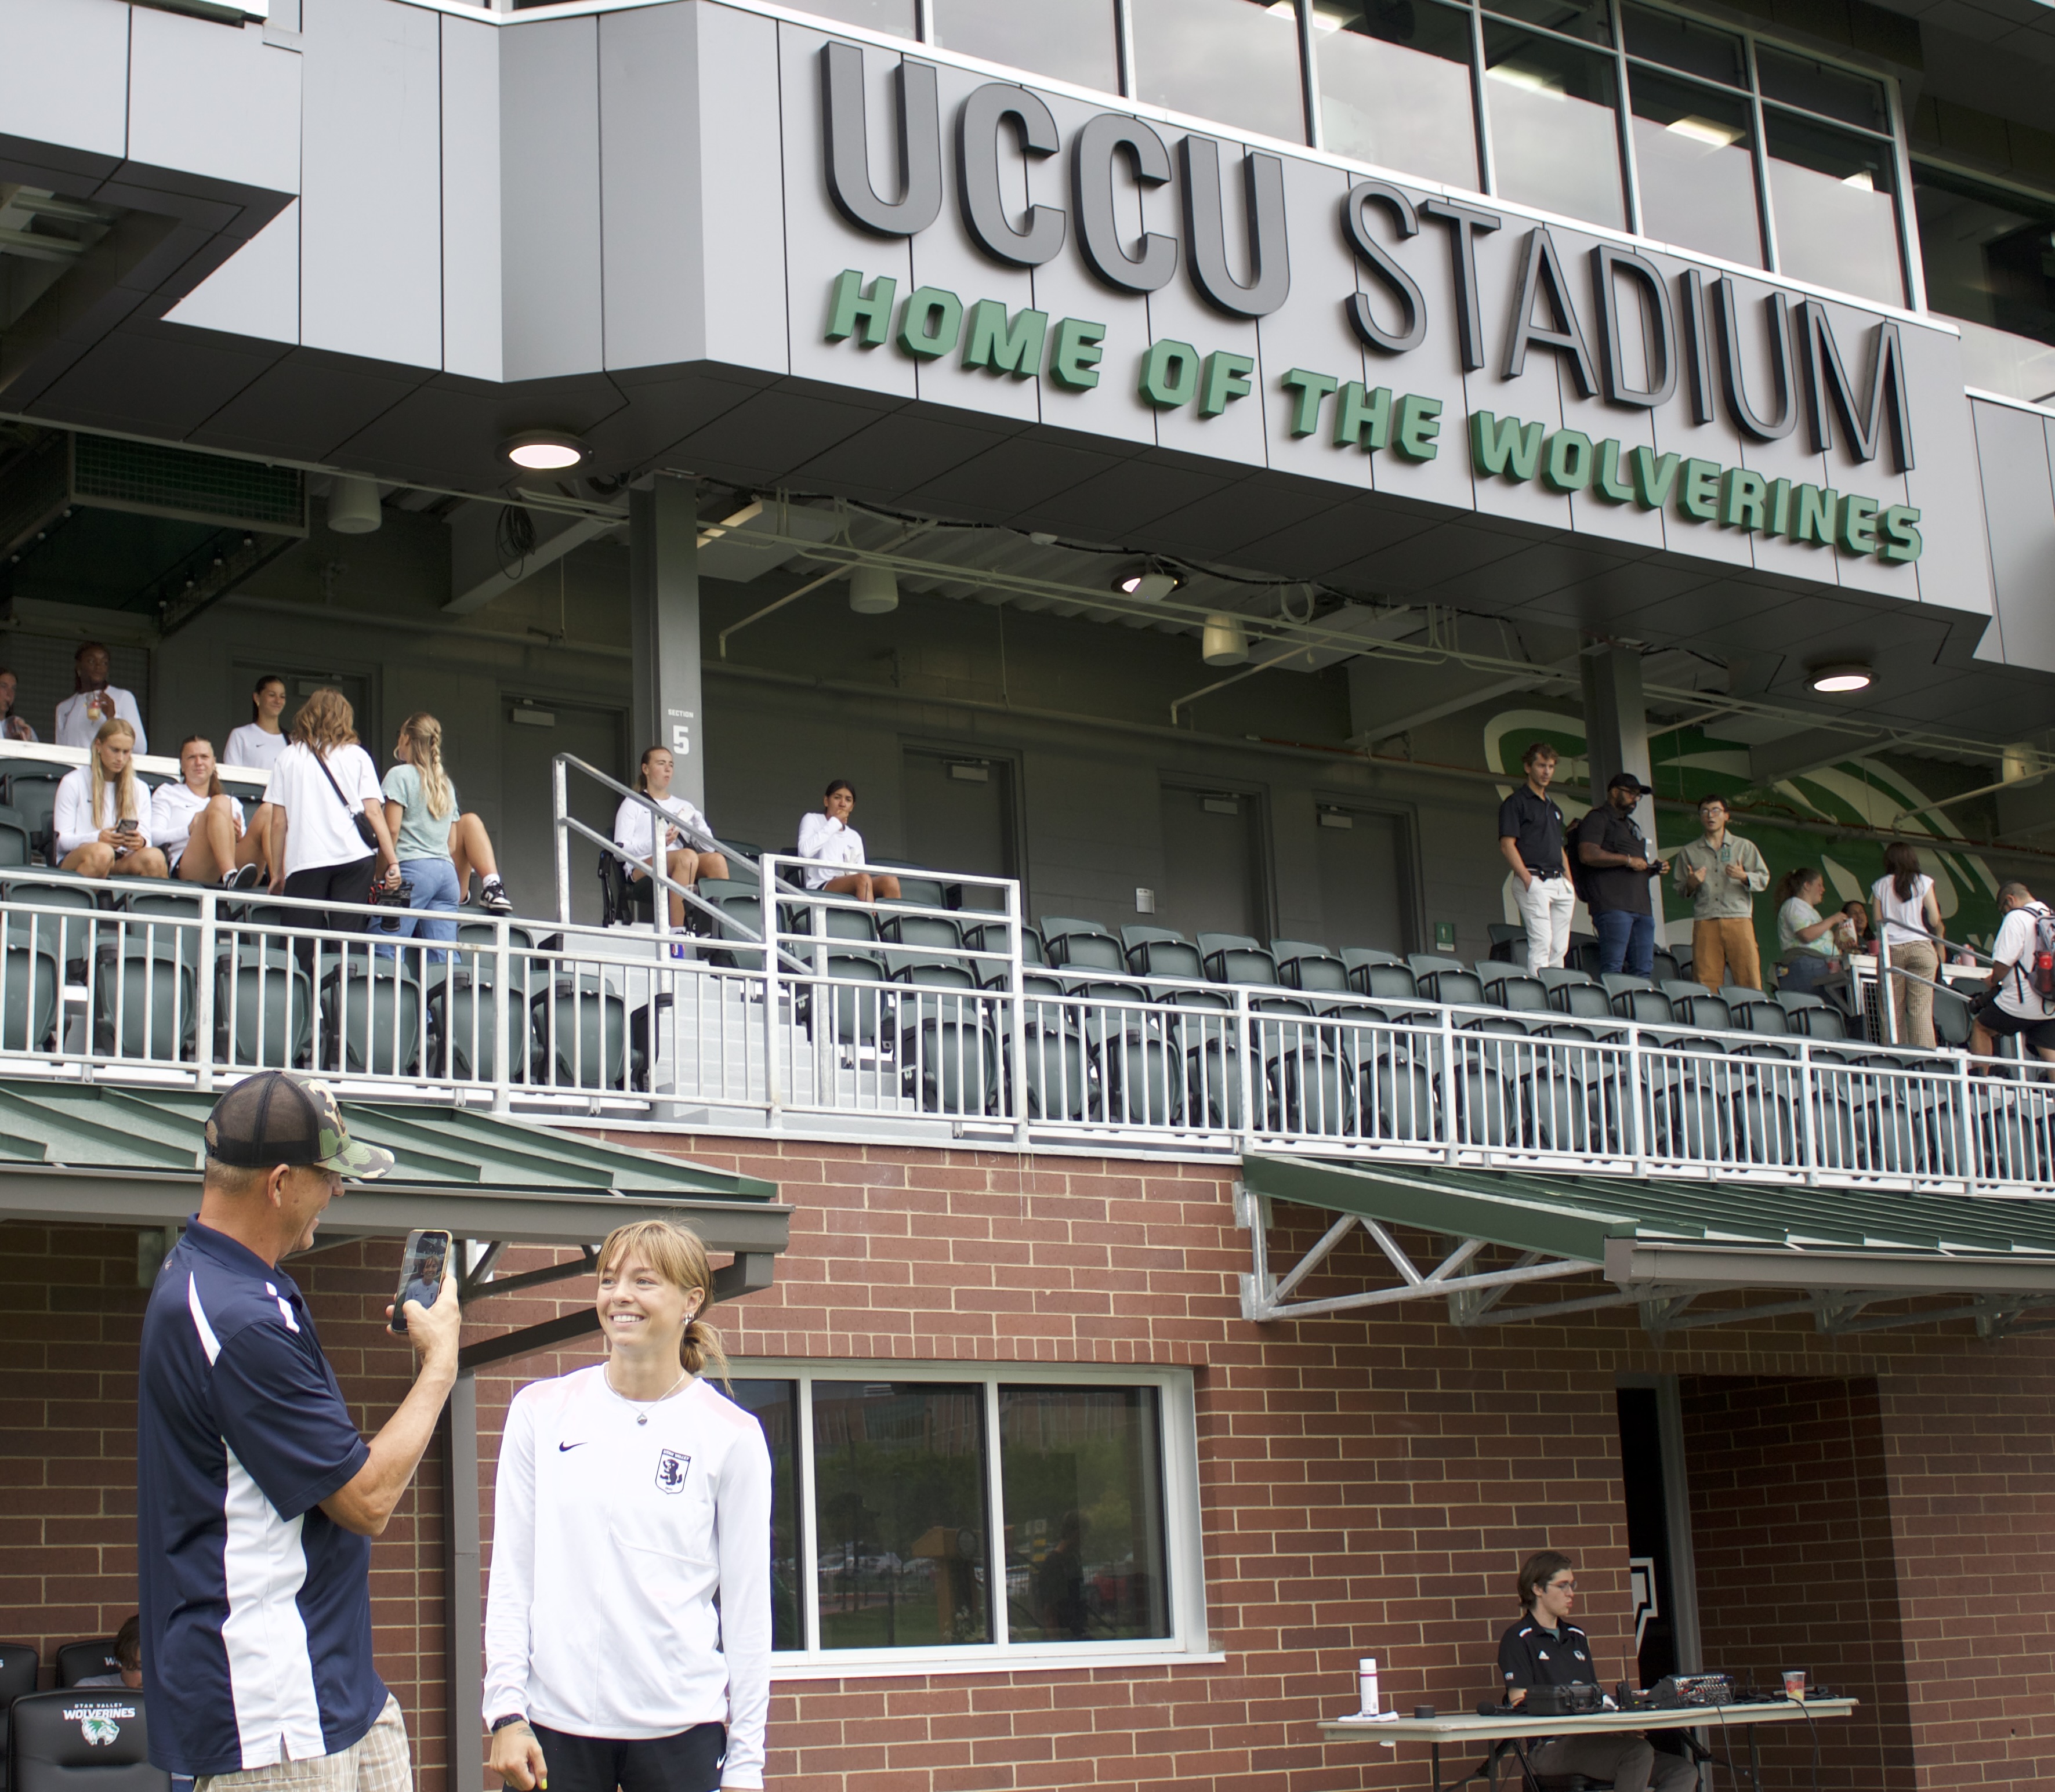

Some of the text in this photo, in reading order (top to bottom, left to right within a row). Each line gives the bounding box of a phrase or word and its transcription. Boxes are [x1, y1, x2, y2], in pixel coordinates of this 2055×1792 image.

[821, 41, 1915, 473] UCCU STADIUM
[824, 269, 1922, 563] HOME OF THE WOLVERINES
[668, 709, 694, 718] SECTION
[673, 725, 689, 754] 5
[63, 1707, 135, 1720] WOLVERINES
